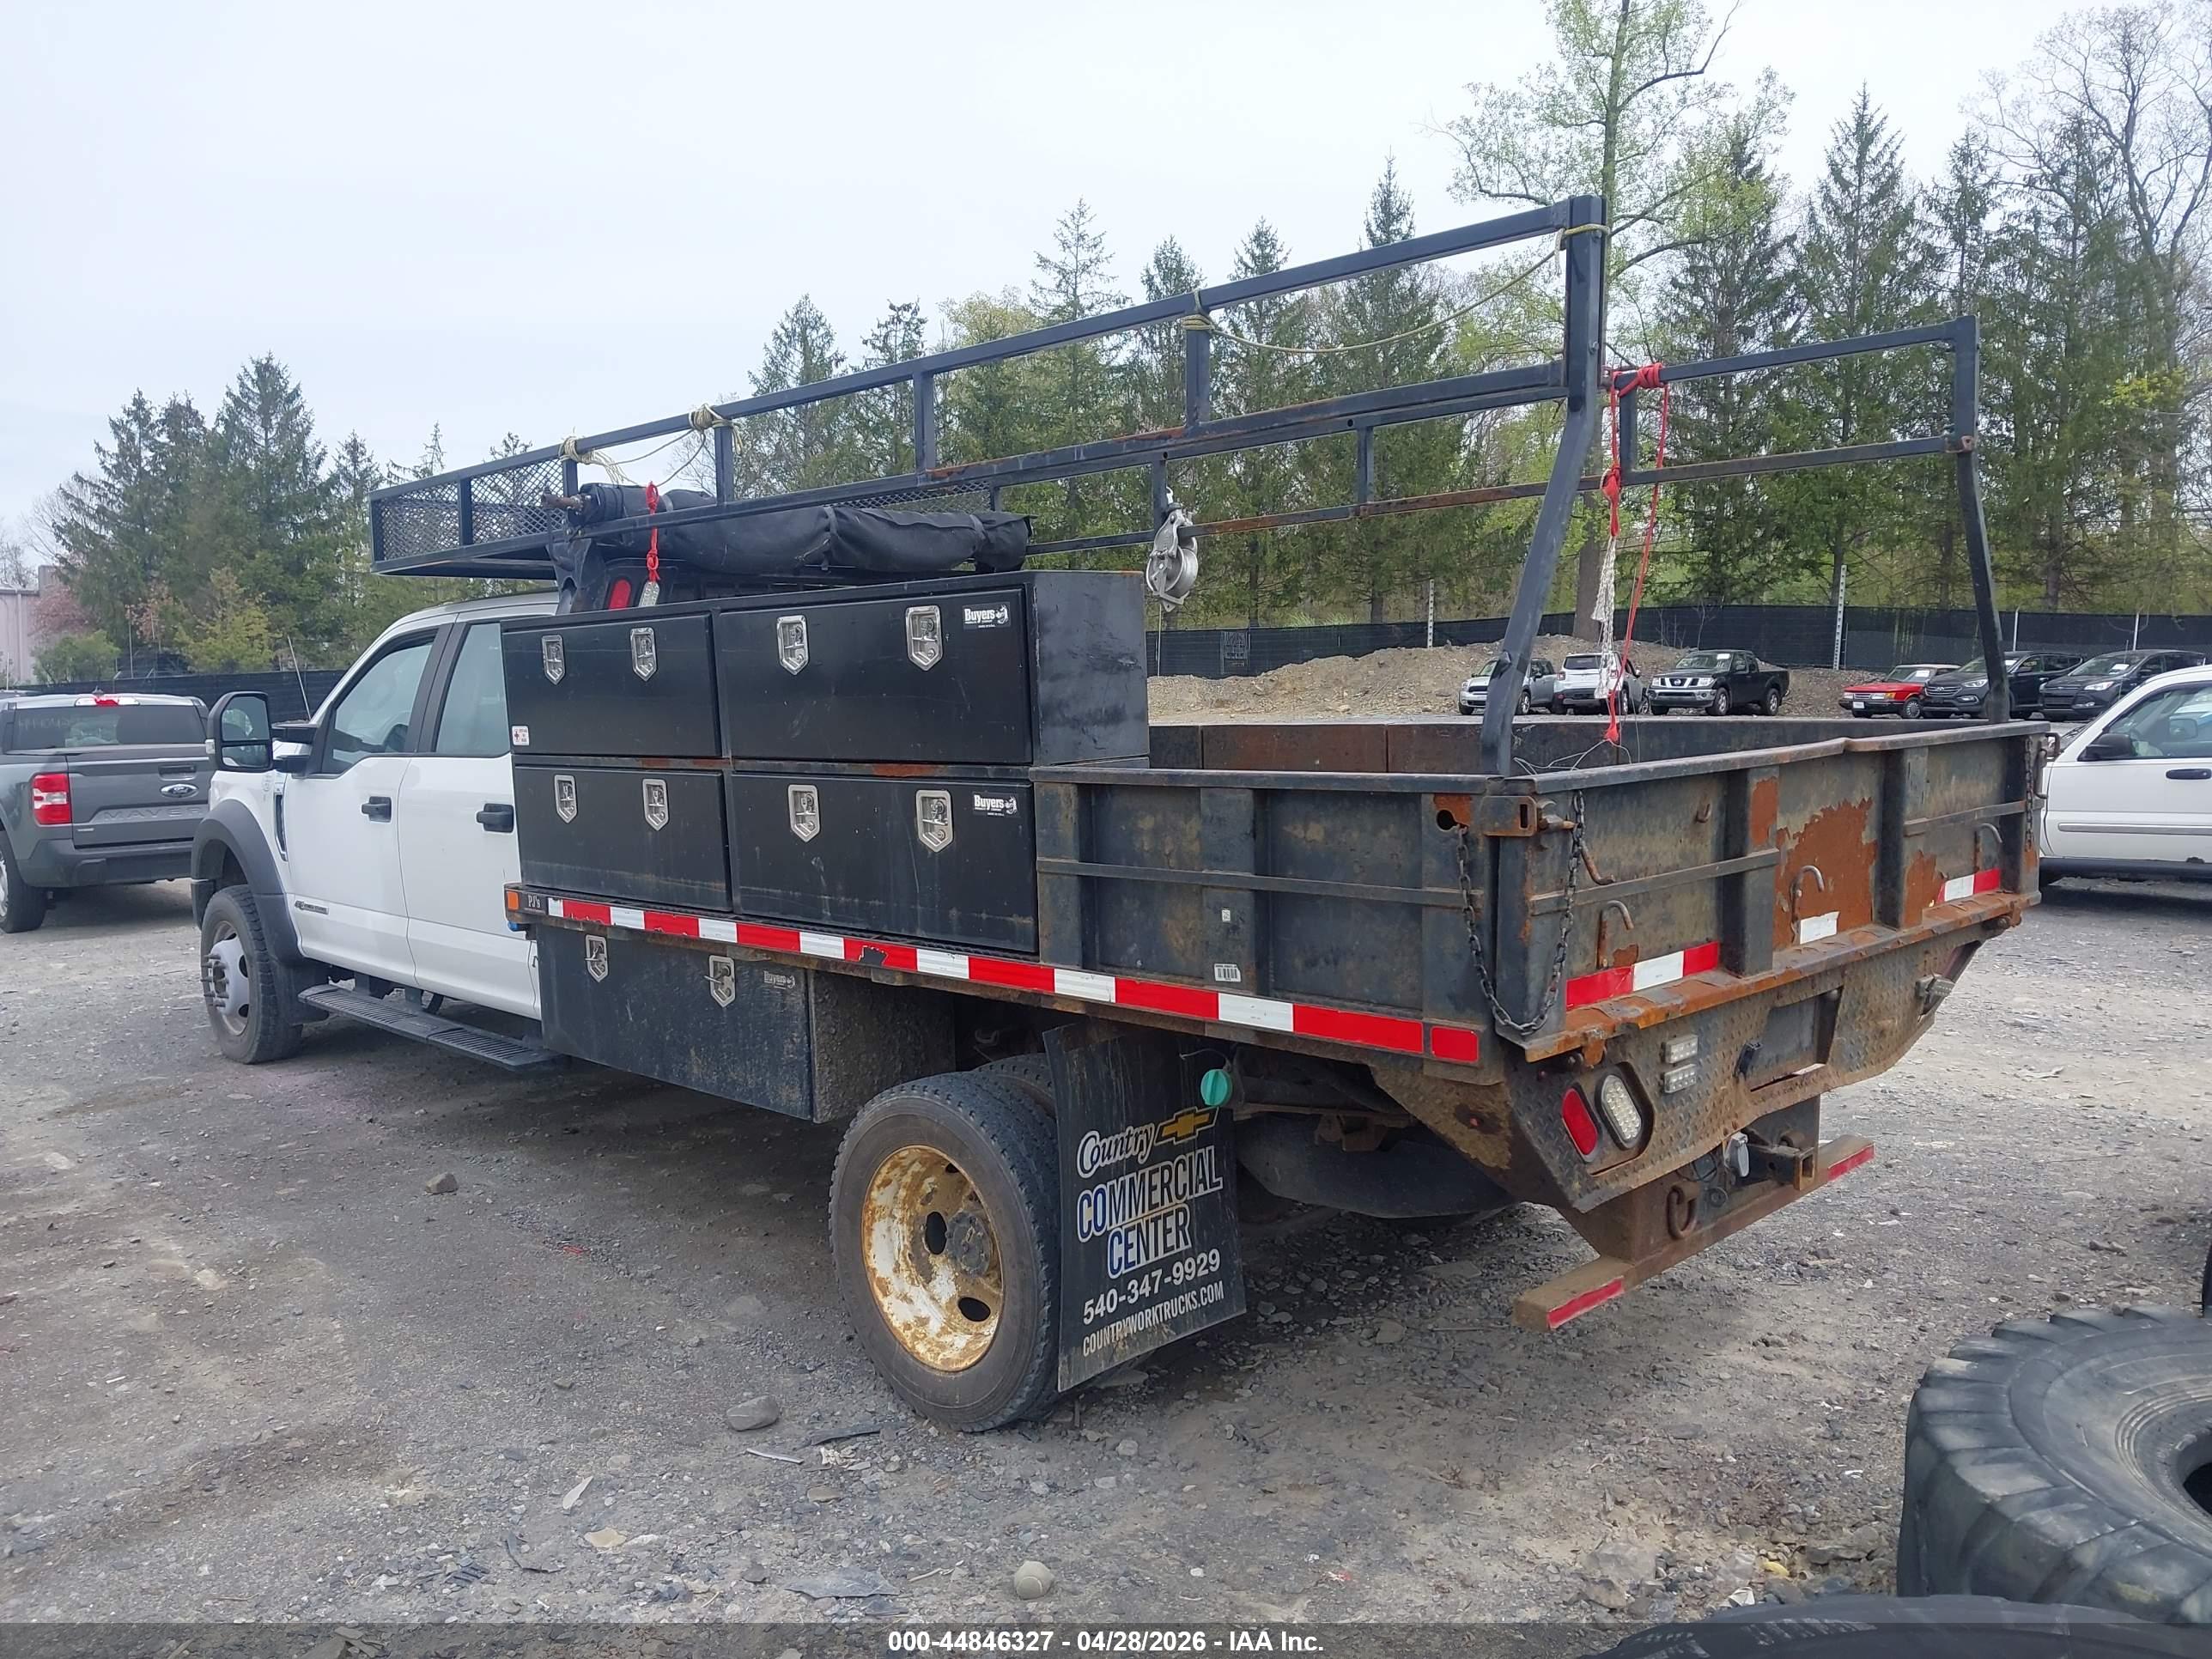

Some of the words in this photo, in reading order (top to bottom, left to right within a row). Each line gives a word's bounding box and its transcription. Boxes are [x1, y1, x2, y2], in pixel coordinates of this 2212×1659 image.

[964, 608, 995, 623] Buyers
[974, 794, 1004, 811] Buyers
[527, 894, 541, 908] PJ's
[1076, 1122, 1155, 1179] Country
[1077, 1145, 1224, 1243] COMMERCIAL
[1107, 1204, 1193, 1279] CENTER
[1082, 1280, 1225, 1358] COUNTRYWORKTRUCKS.COM
[1083, 1248, 1221, 1325] 540-347-9929
